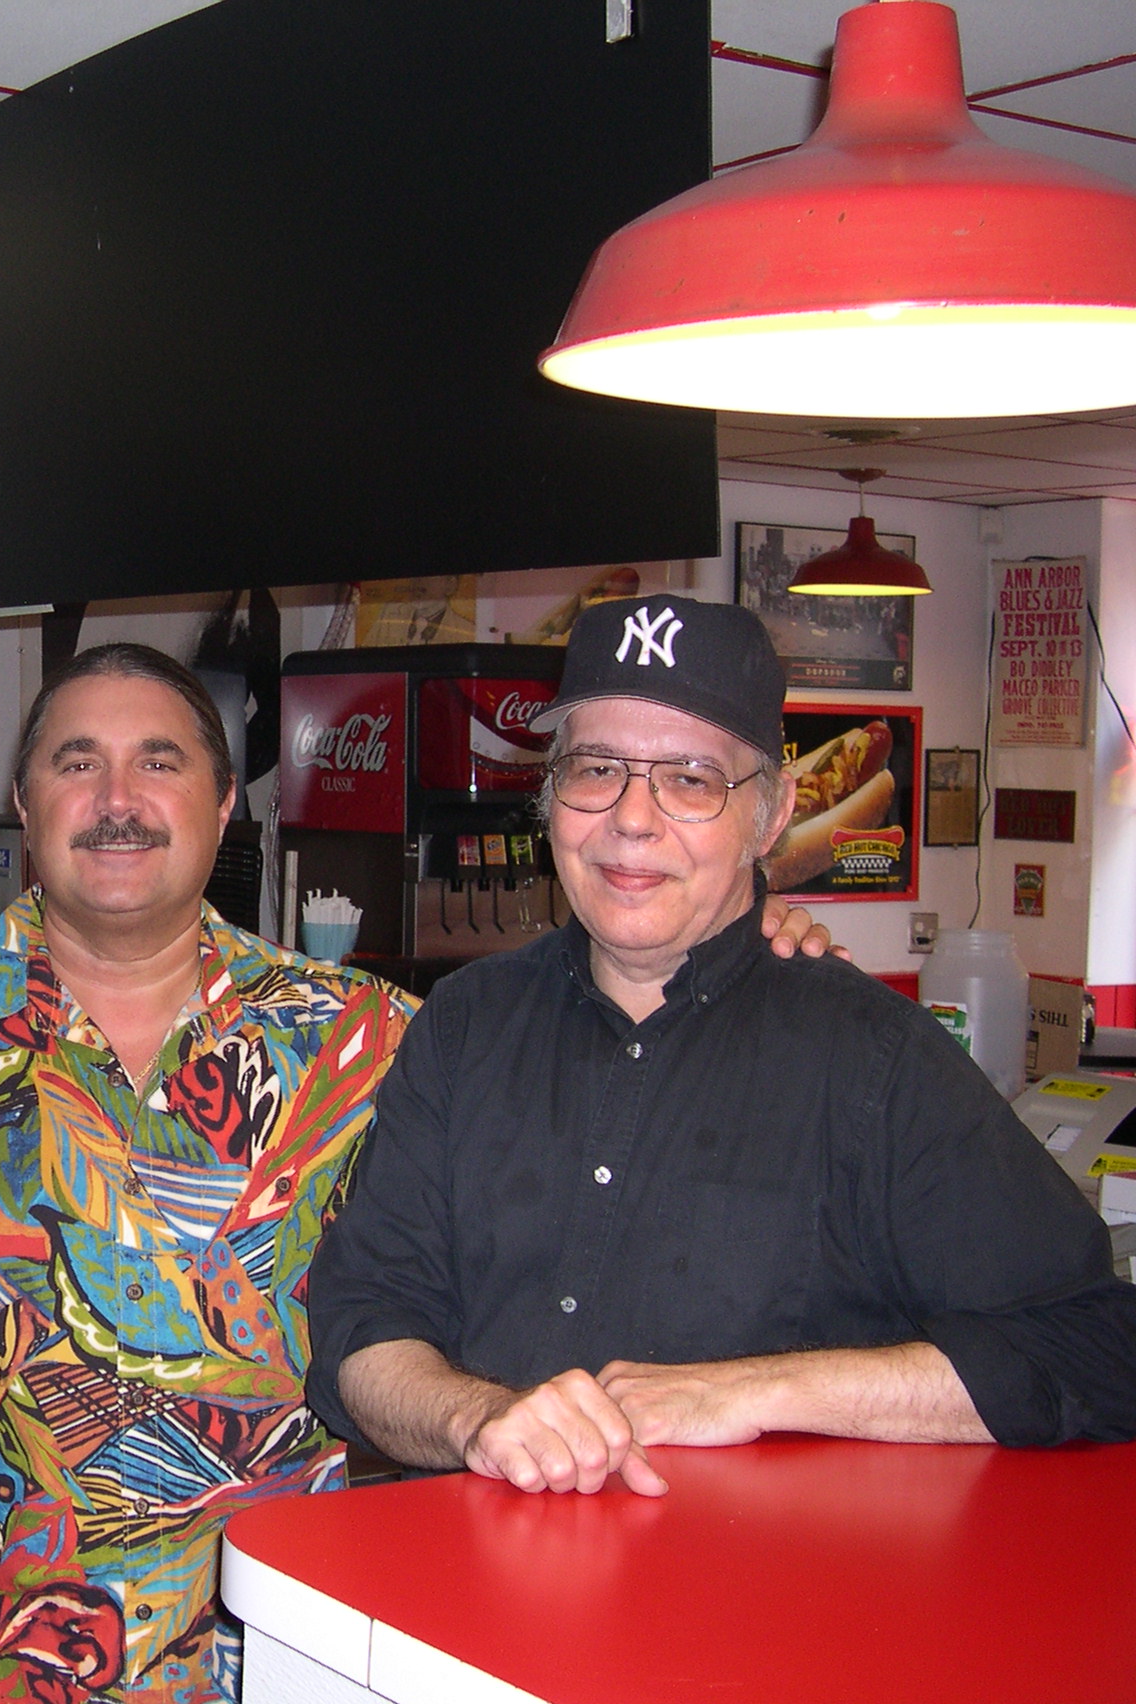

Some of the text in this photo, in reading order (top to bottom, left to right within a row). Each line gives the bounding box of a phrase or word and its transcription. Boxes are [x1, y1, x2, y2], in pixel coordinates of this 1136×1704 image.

[1004, 565, 1080, 589] ANN ARBOR
[1000, 587, 1083, 611] BLUES & JAZZ
[1003, 612, 1080, 636] FESTIVAL
[615, 606, 684, 668] NY
[1000, 640, 1042, 657] SEPT.
[1010, 660, 1072, 677] BO DIDDLEY
[1002, 679, 1080, 696] MACEO PARKER
[320, 776, 357, 792] CLASSIC
[1039, 1009, 1070, 1028] THIS
